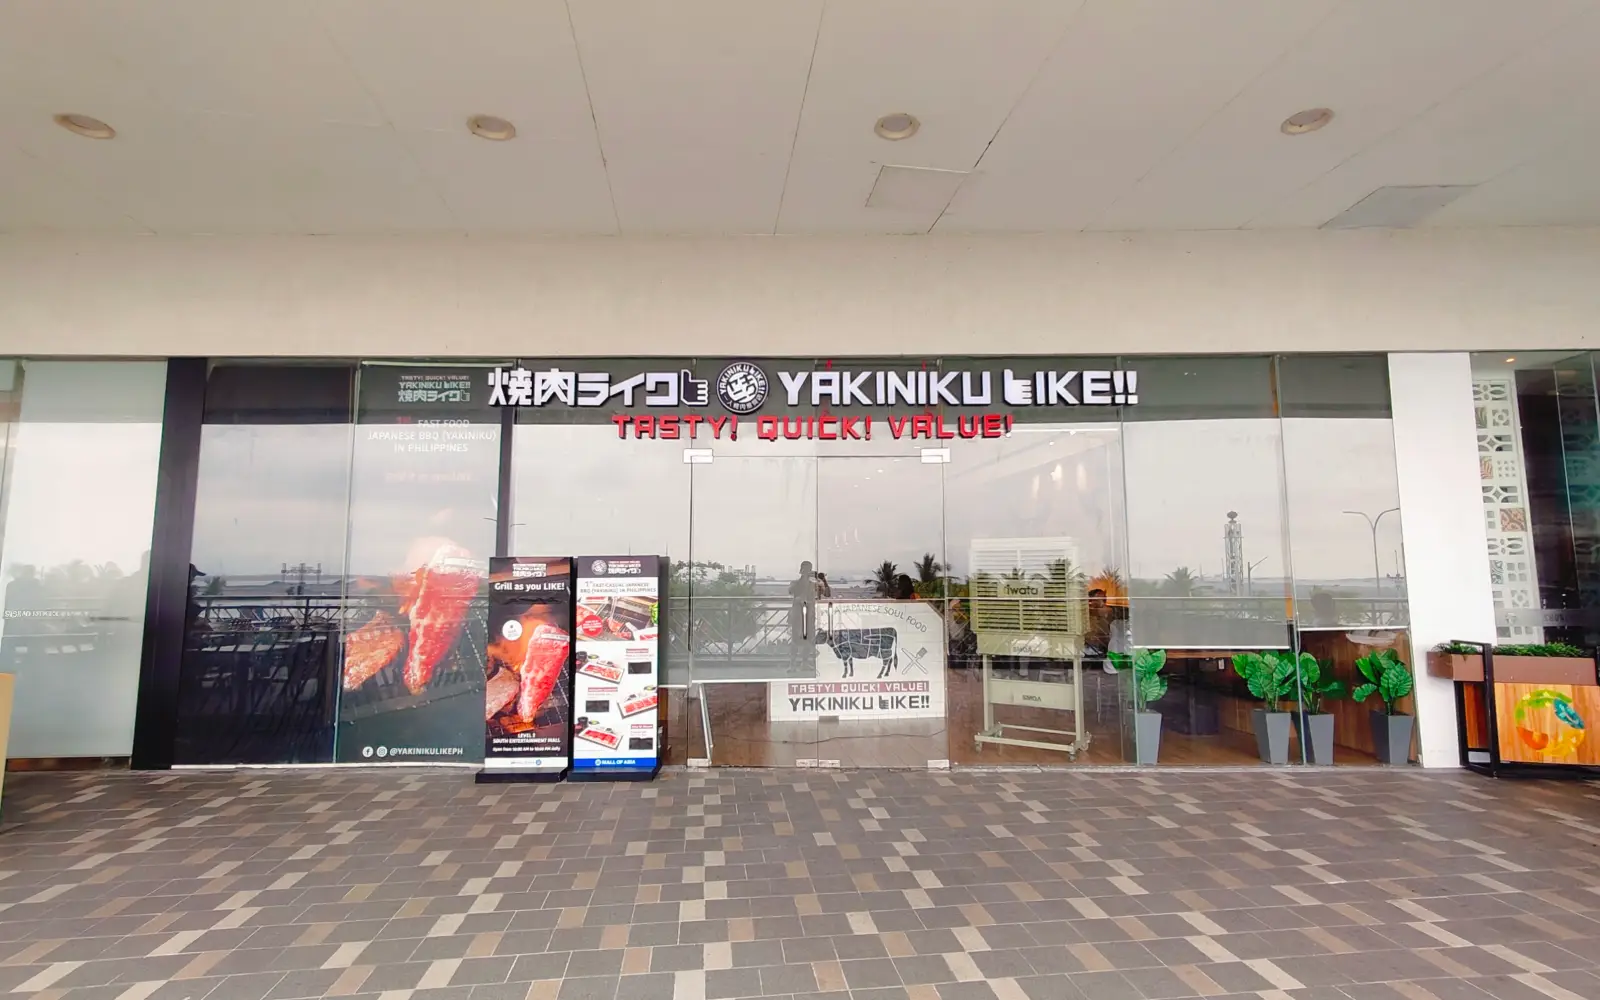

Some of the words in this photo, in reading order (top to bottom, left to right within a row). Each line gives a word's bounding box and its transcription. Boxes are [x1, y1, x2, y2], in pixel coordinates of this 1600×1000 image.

[398, 381, 442, 389] YAKINIKU
[488, 367, 679, 406] 焼肉ライク
[777, 370, 991, 406] YAKINIKU
[418, 419, 441, 428] FAST
[443, 419, 470, 428] FOOD
[611, 415, 738, 440] TASTY!
[757, 415, 873, 441] QUICK!
[887, 414, 1014, 439] VALUE!
[368, 431, 415, 441] JAPANESE
[418, 431, 439, 441] BBQ
[442, 430, 497, 442] (YAKINIKU)
[394, 443, 404, 453] IN
[408, 443, 469, 453] PHILIPPINES
[494, 582, 513, 591] Grill
[526, 583, 541, 592] you
[543, 582, 565, 590] LIKE!
[1005, 584, 1039, 596] iwata
[842, 605, 881, 614] JAPANESE
[884, 606, 905, 620] SOUL
[905, 615, 928, 633] FOOD
[791, 684, 836, 693] TASTY!
[840, 683, 880, 692] QUICK!
[885, 682, 927, 691] VALUE!
[788, 695, 874, 712] YAKINIKU
[389, 747, 464, 756] @YAKINIKULIKEPH
